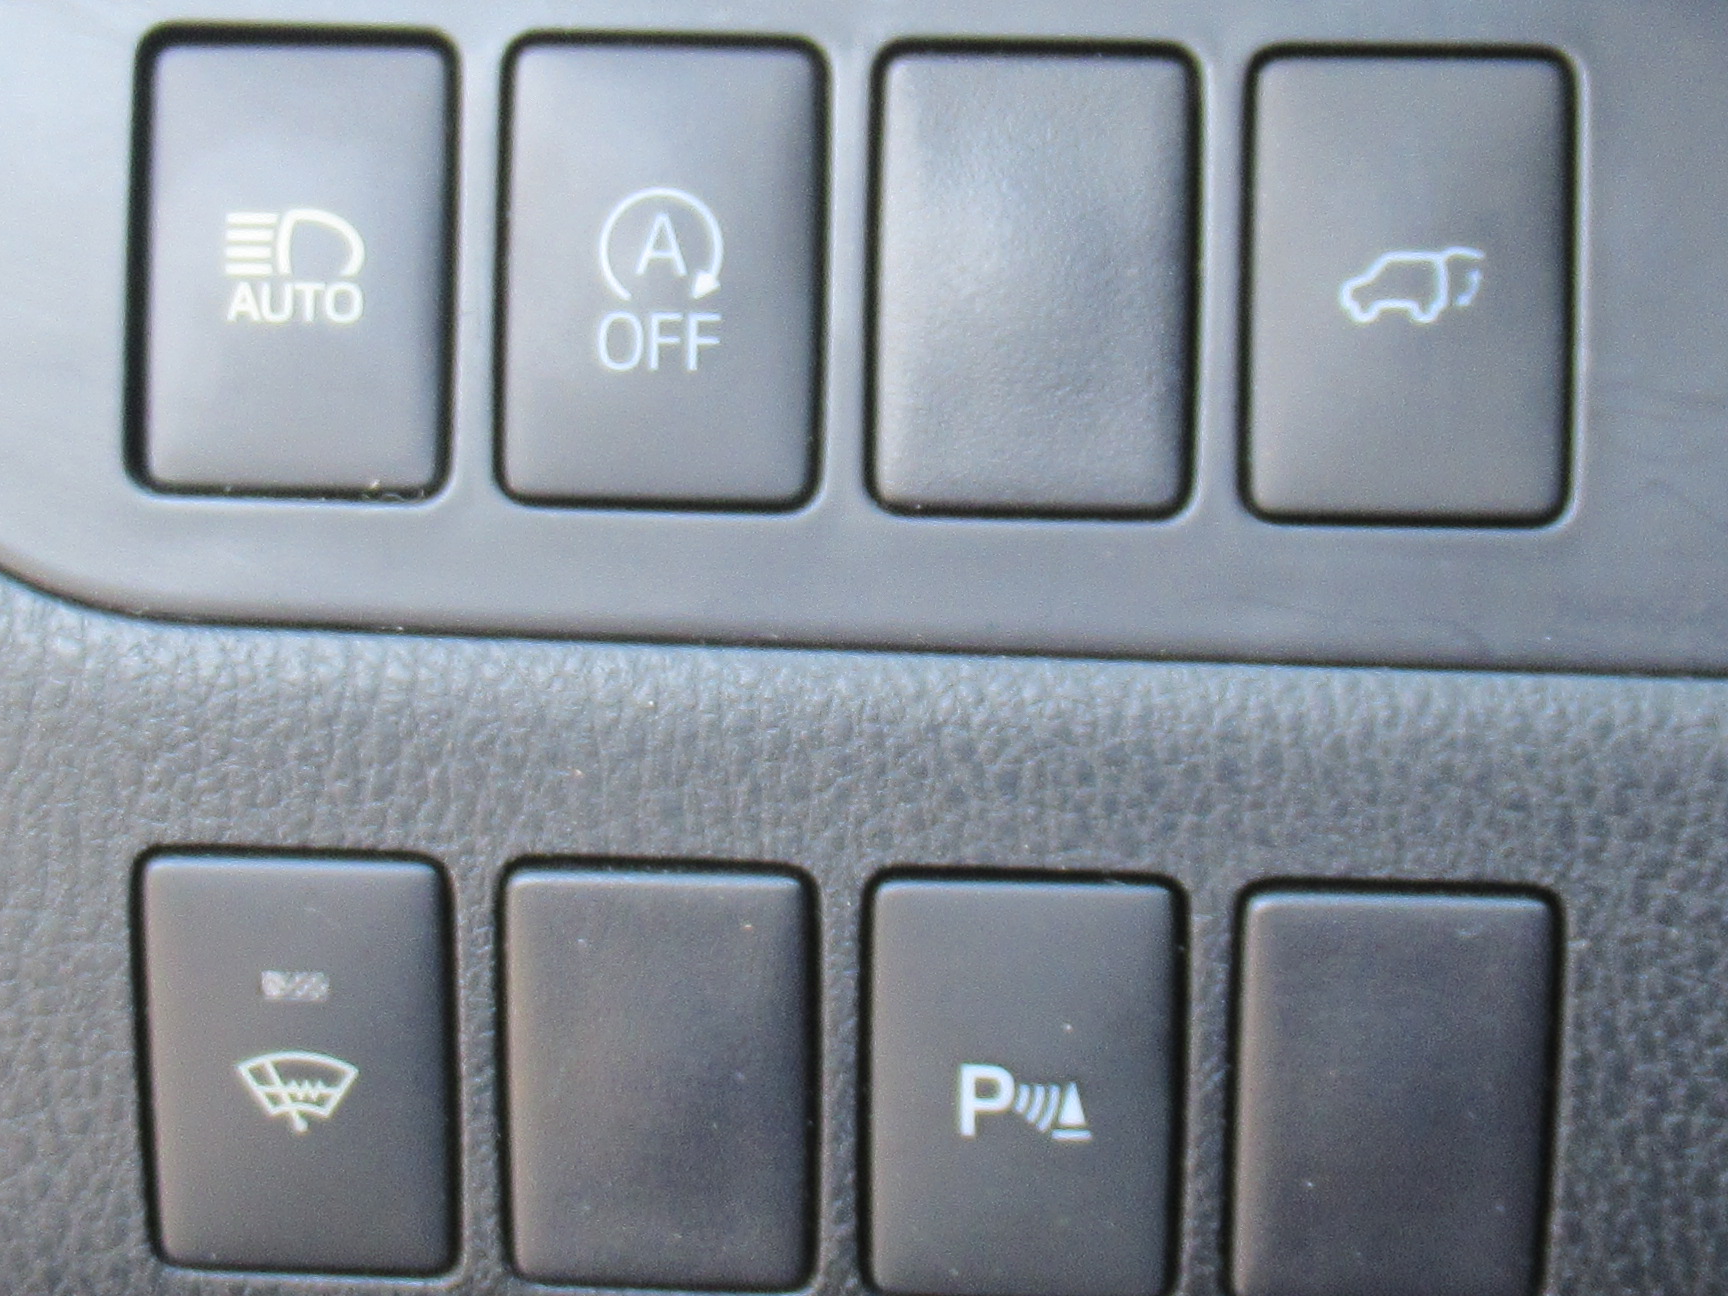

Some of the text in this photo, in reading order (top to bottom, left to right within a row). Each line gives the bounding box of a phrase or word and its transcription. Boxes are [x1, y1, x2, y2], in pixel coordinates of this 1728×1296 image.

[636, 212, 687, 276] A
[227, 282, 363, 323] AUTO
[597, 311, 721, 371] OFF
[959, 1064, 1013, 1138] P
